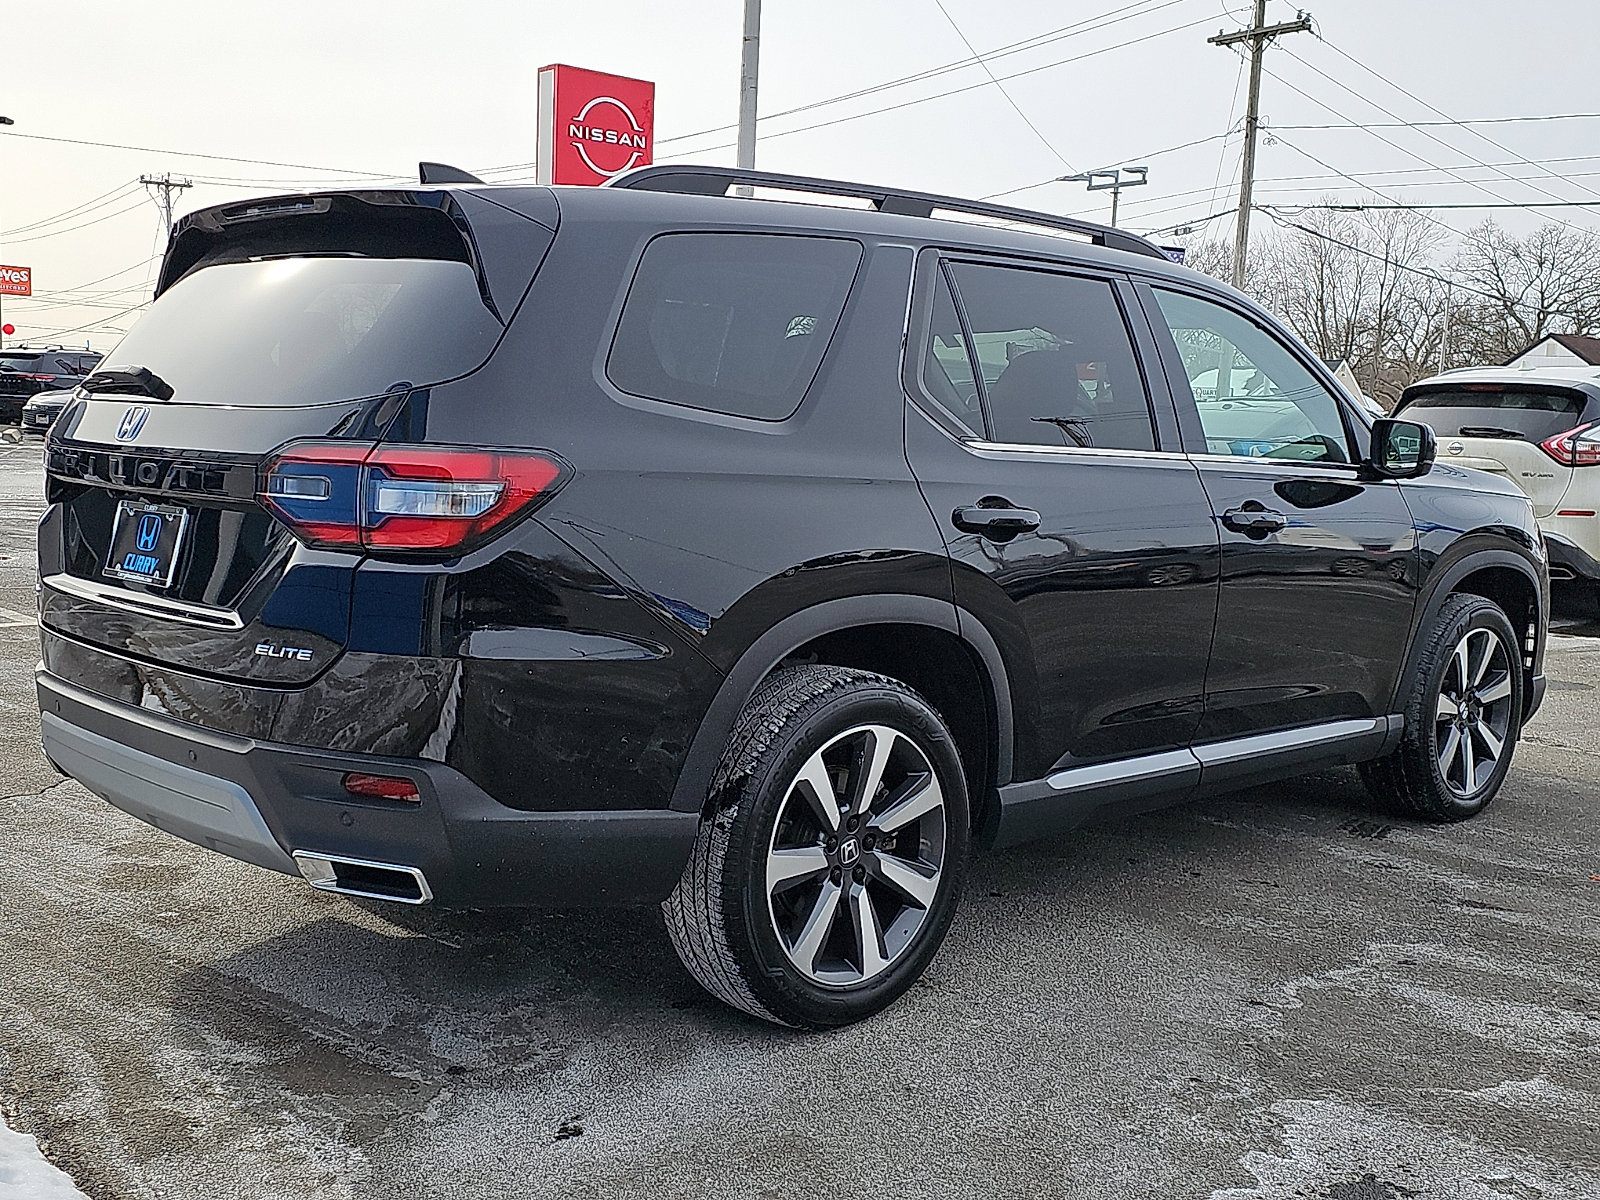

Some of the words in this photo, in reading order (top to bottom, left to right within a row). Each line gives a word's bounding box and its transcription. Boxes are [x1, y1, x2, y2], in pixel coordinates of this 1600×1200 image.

[569, 124, 646, 149] NISSAN
[123, 552, 160, 575] CURRY
[254, 643, 314, 661] ELITE
